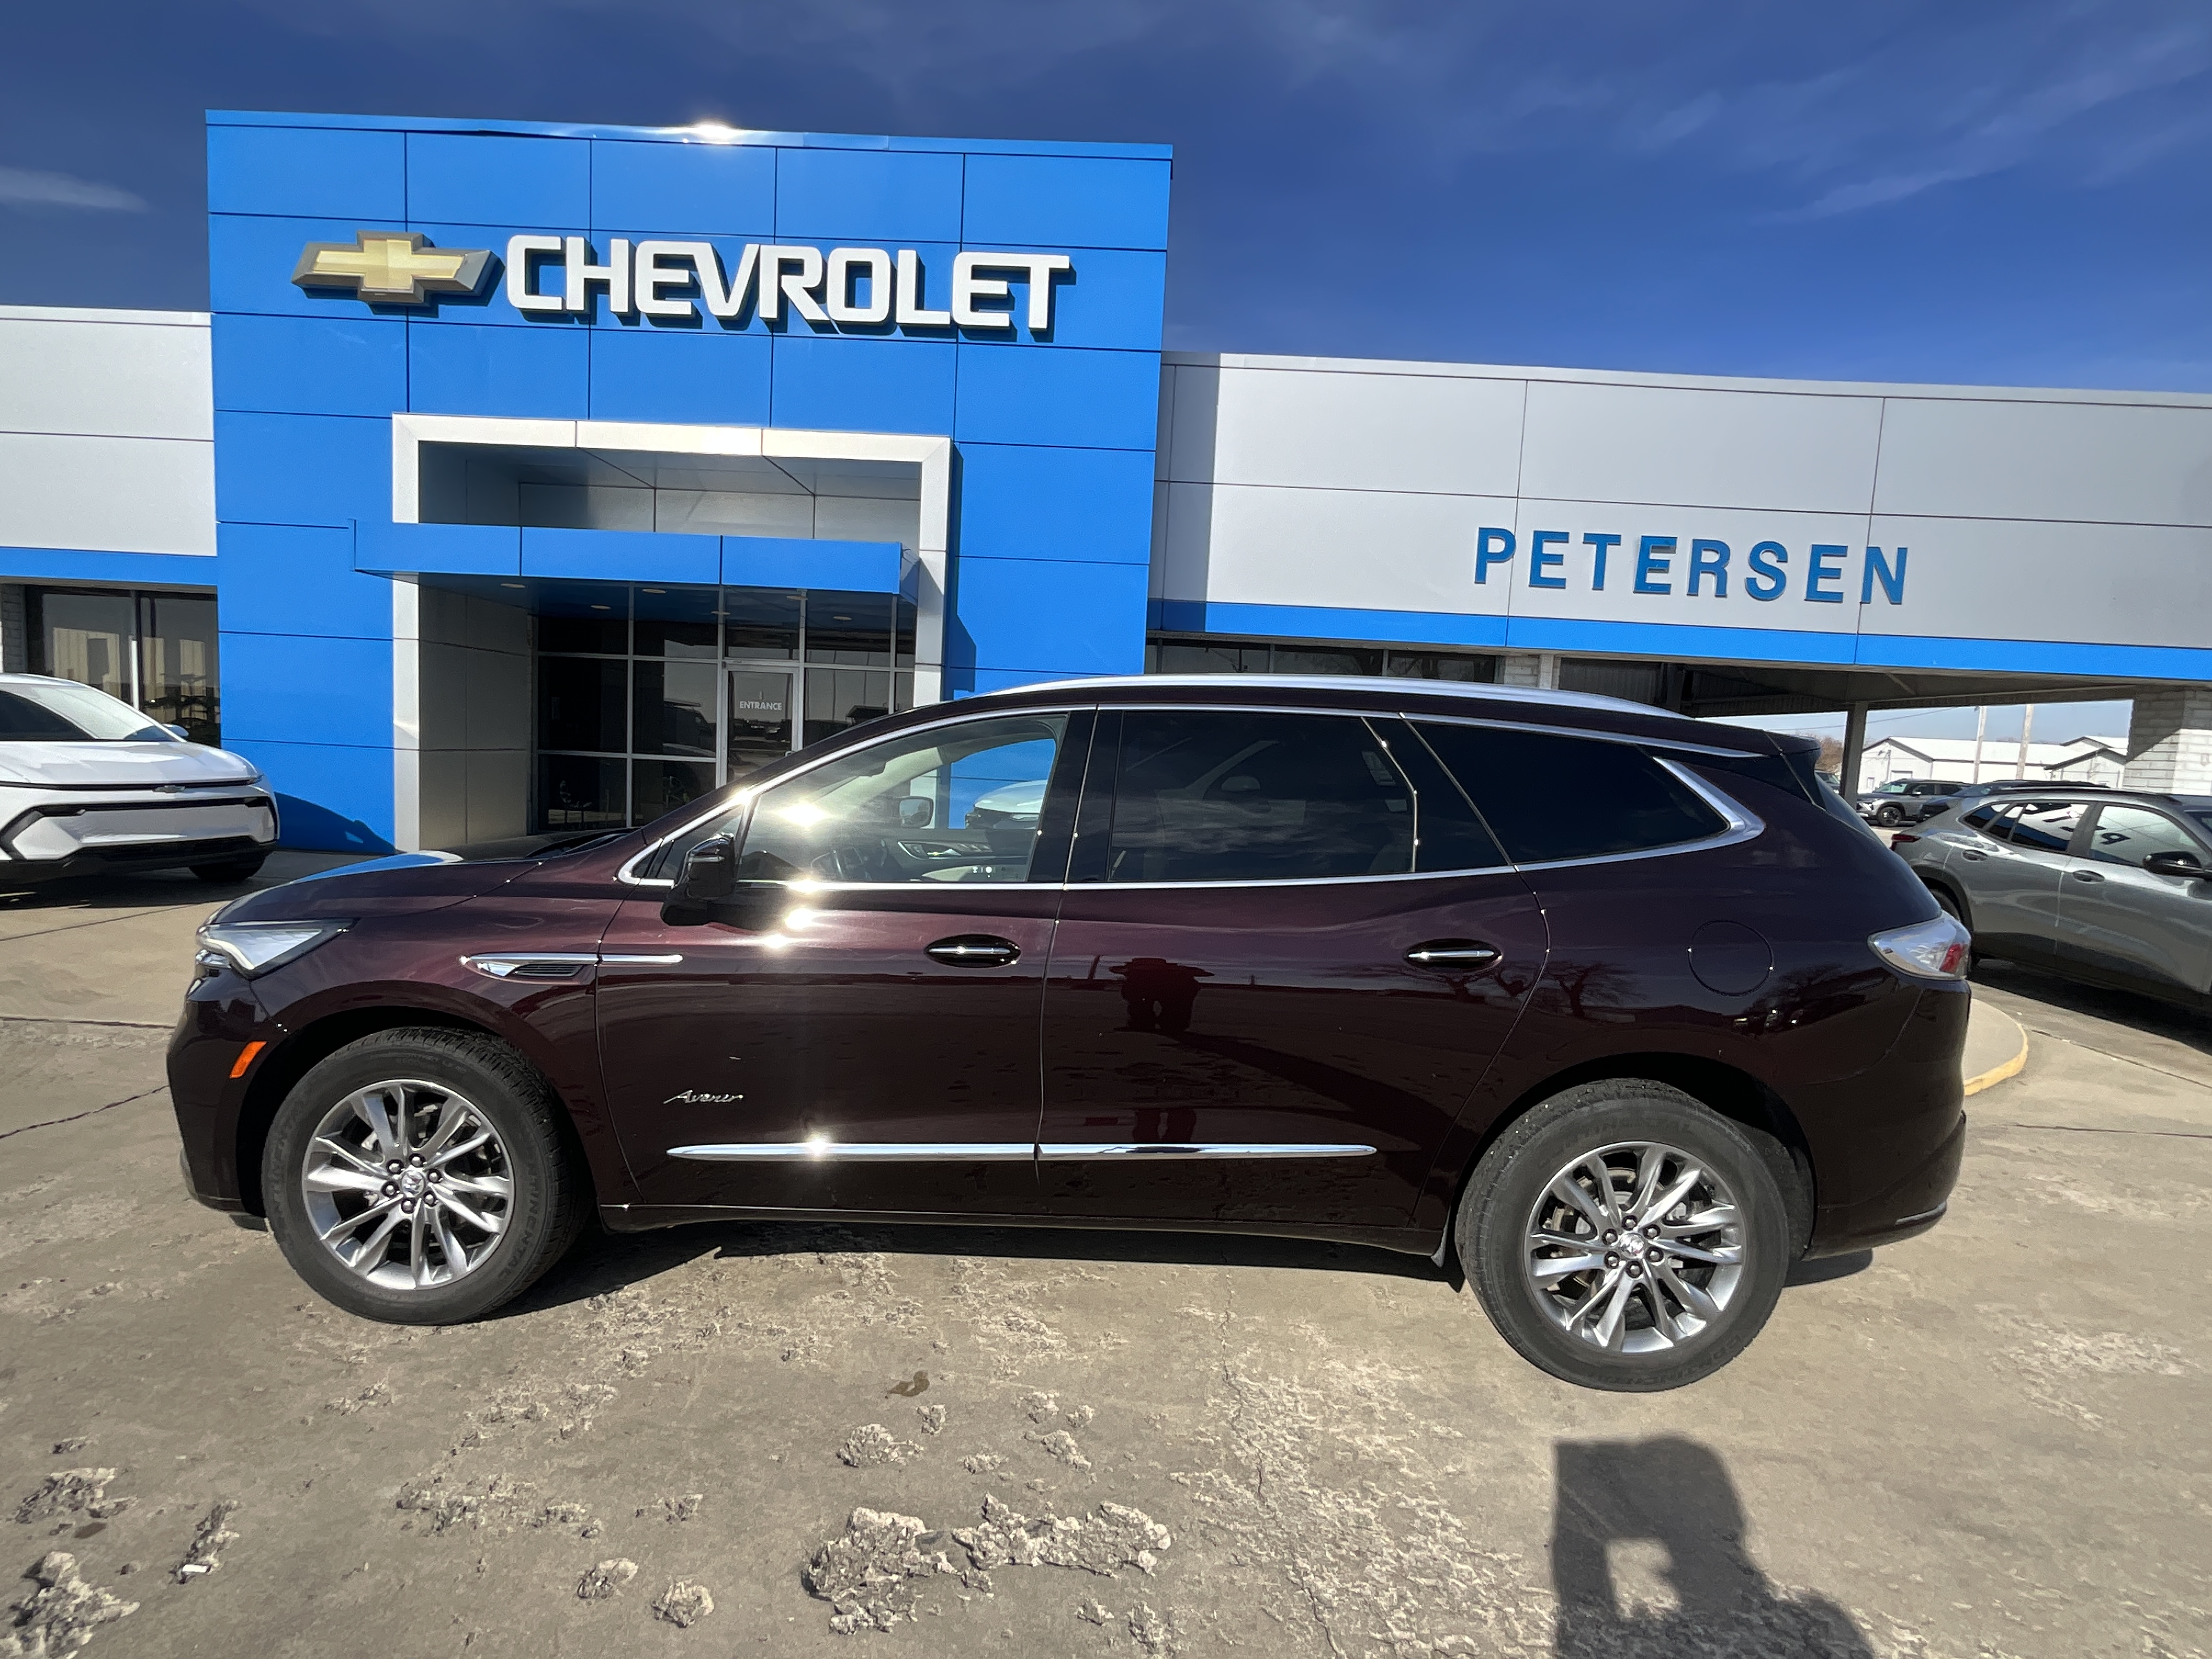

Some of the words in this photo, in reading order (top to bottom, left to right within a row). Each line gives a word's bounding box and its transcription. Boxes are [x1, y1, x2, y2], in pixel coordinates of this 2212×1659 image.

[505, 234, 1070, 330] CHEVROLET
[1474, 527, 1908, 605] PETERSEN
[739, 701, 782, 710] ENTRANCE
